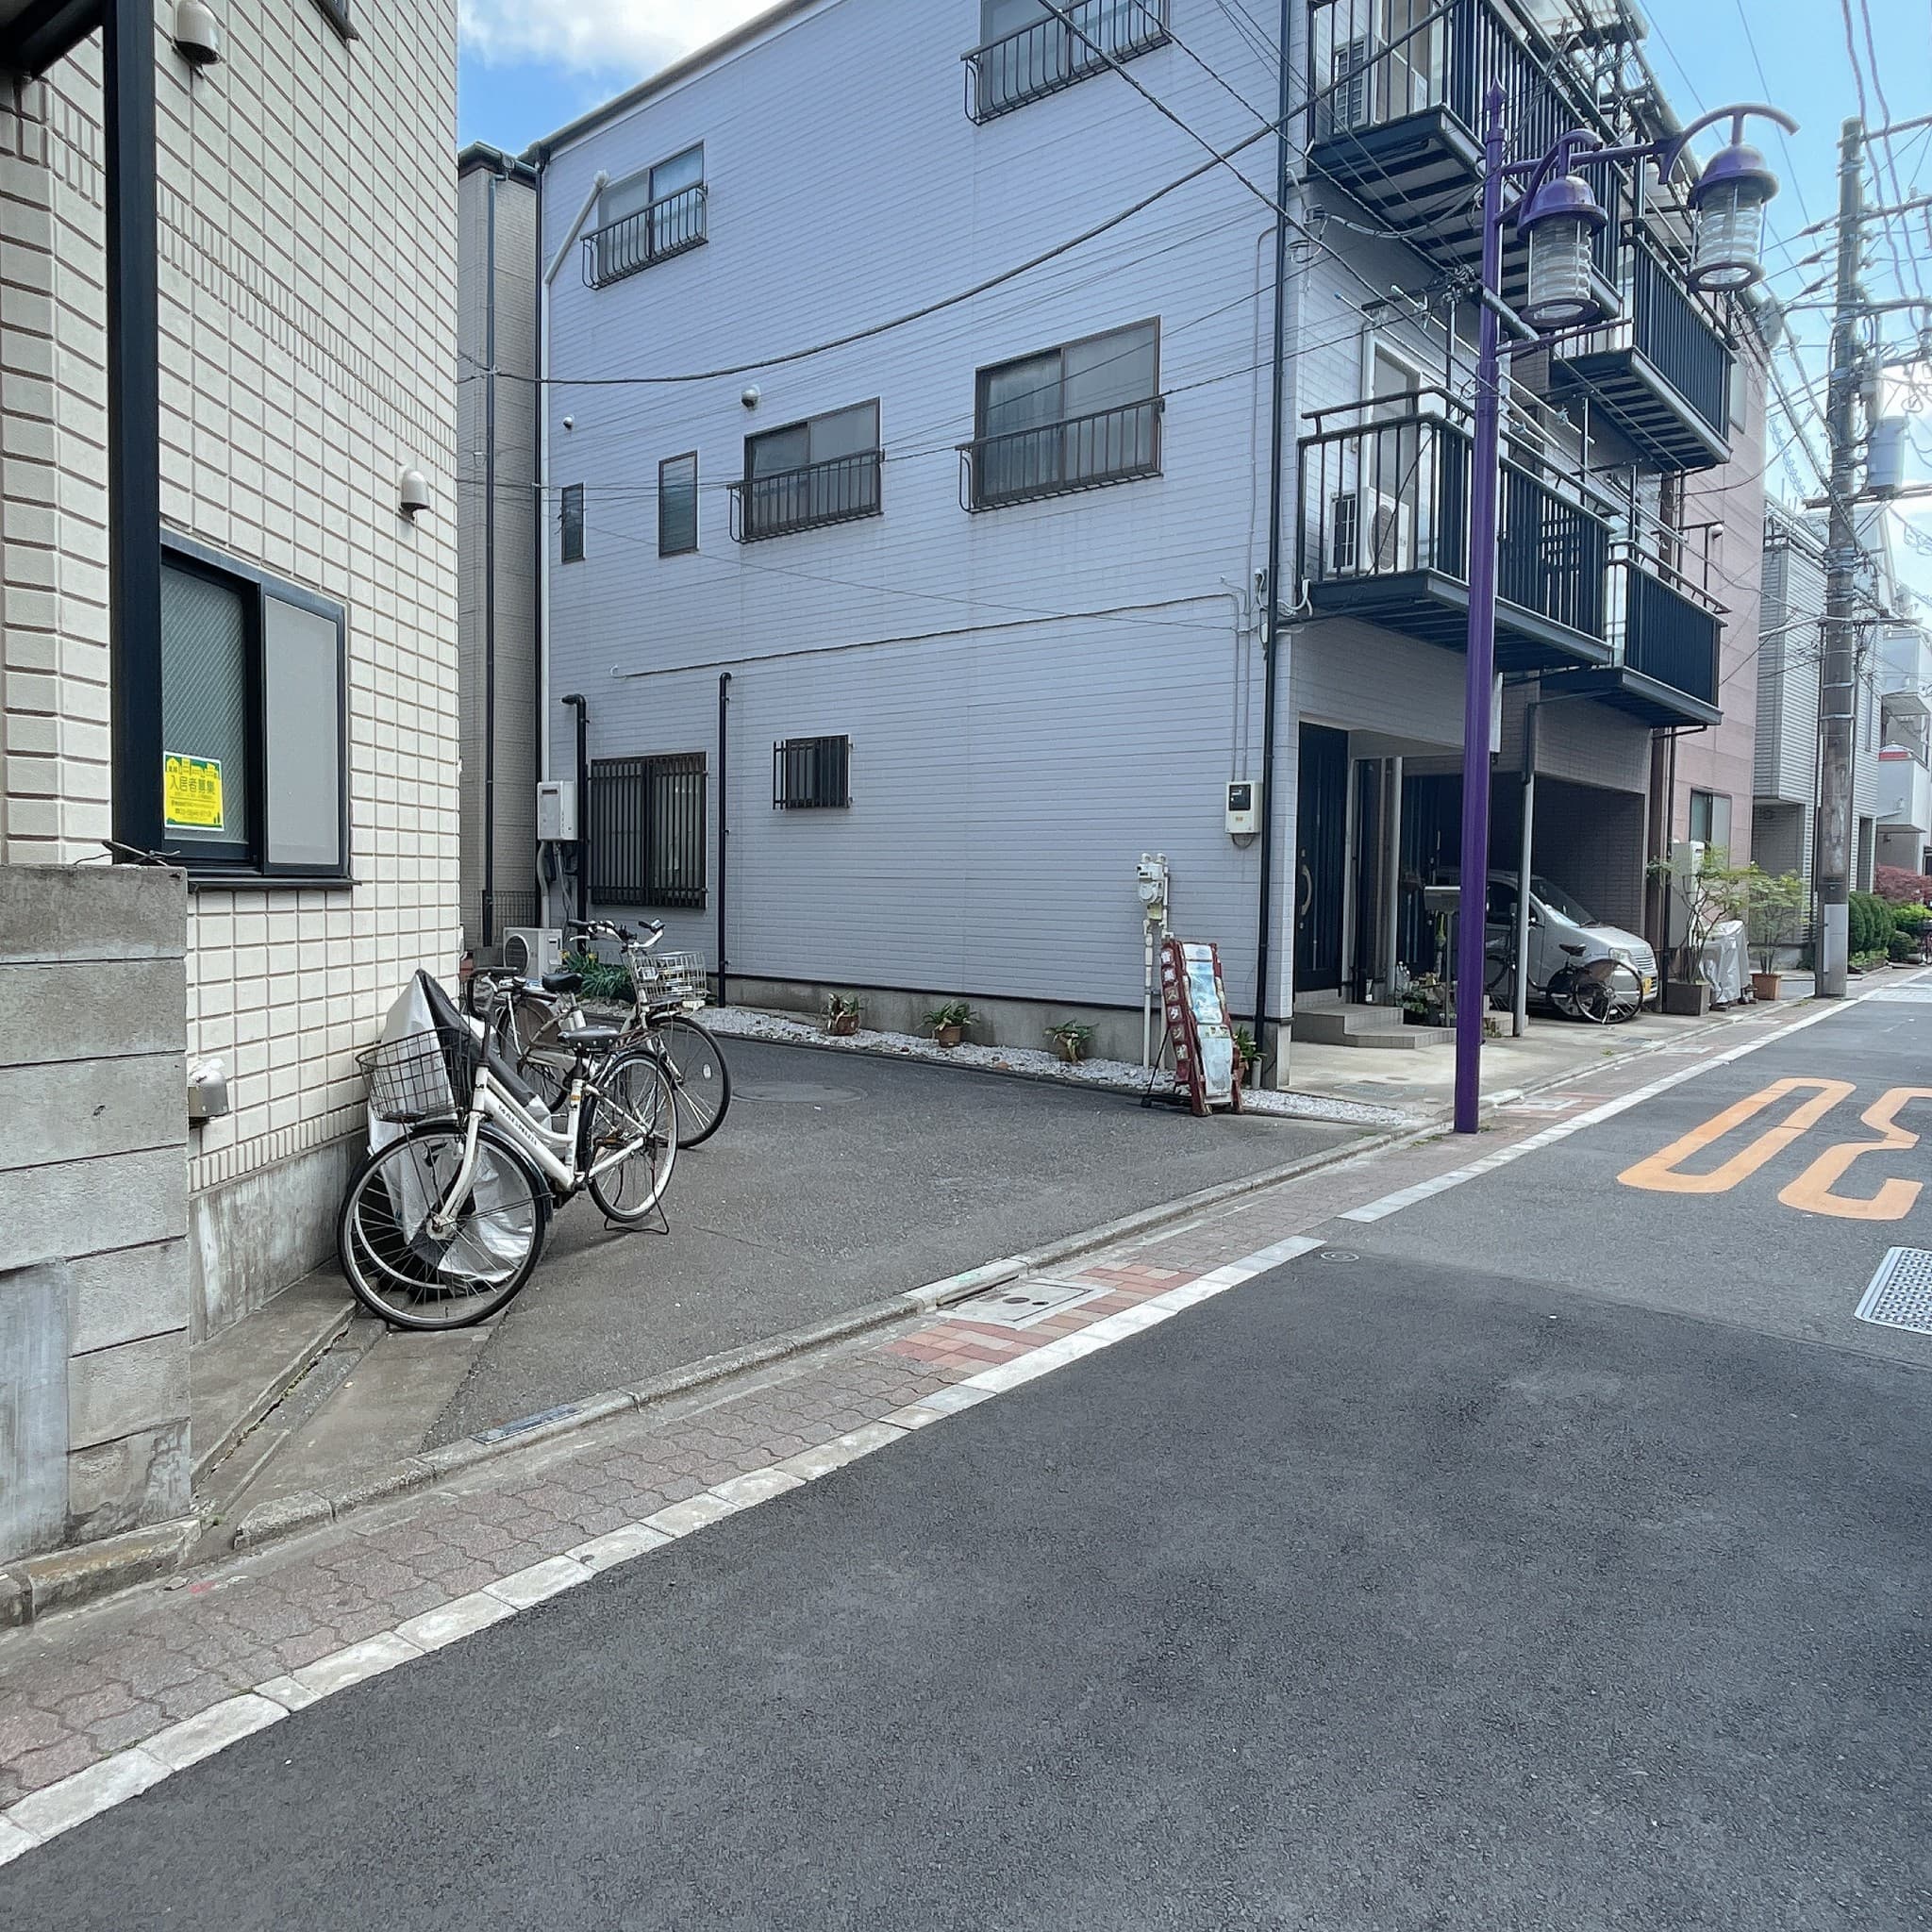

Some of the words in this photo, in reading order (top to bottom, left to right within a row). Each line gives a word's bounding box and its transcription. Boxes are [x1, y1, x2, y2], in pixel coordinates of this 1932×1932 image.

[169, 774, 216, 795] 入居者募集
